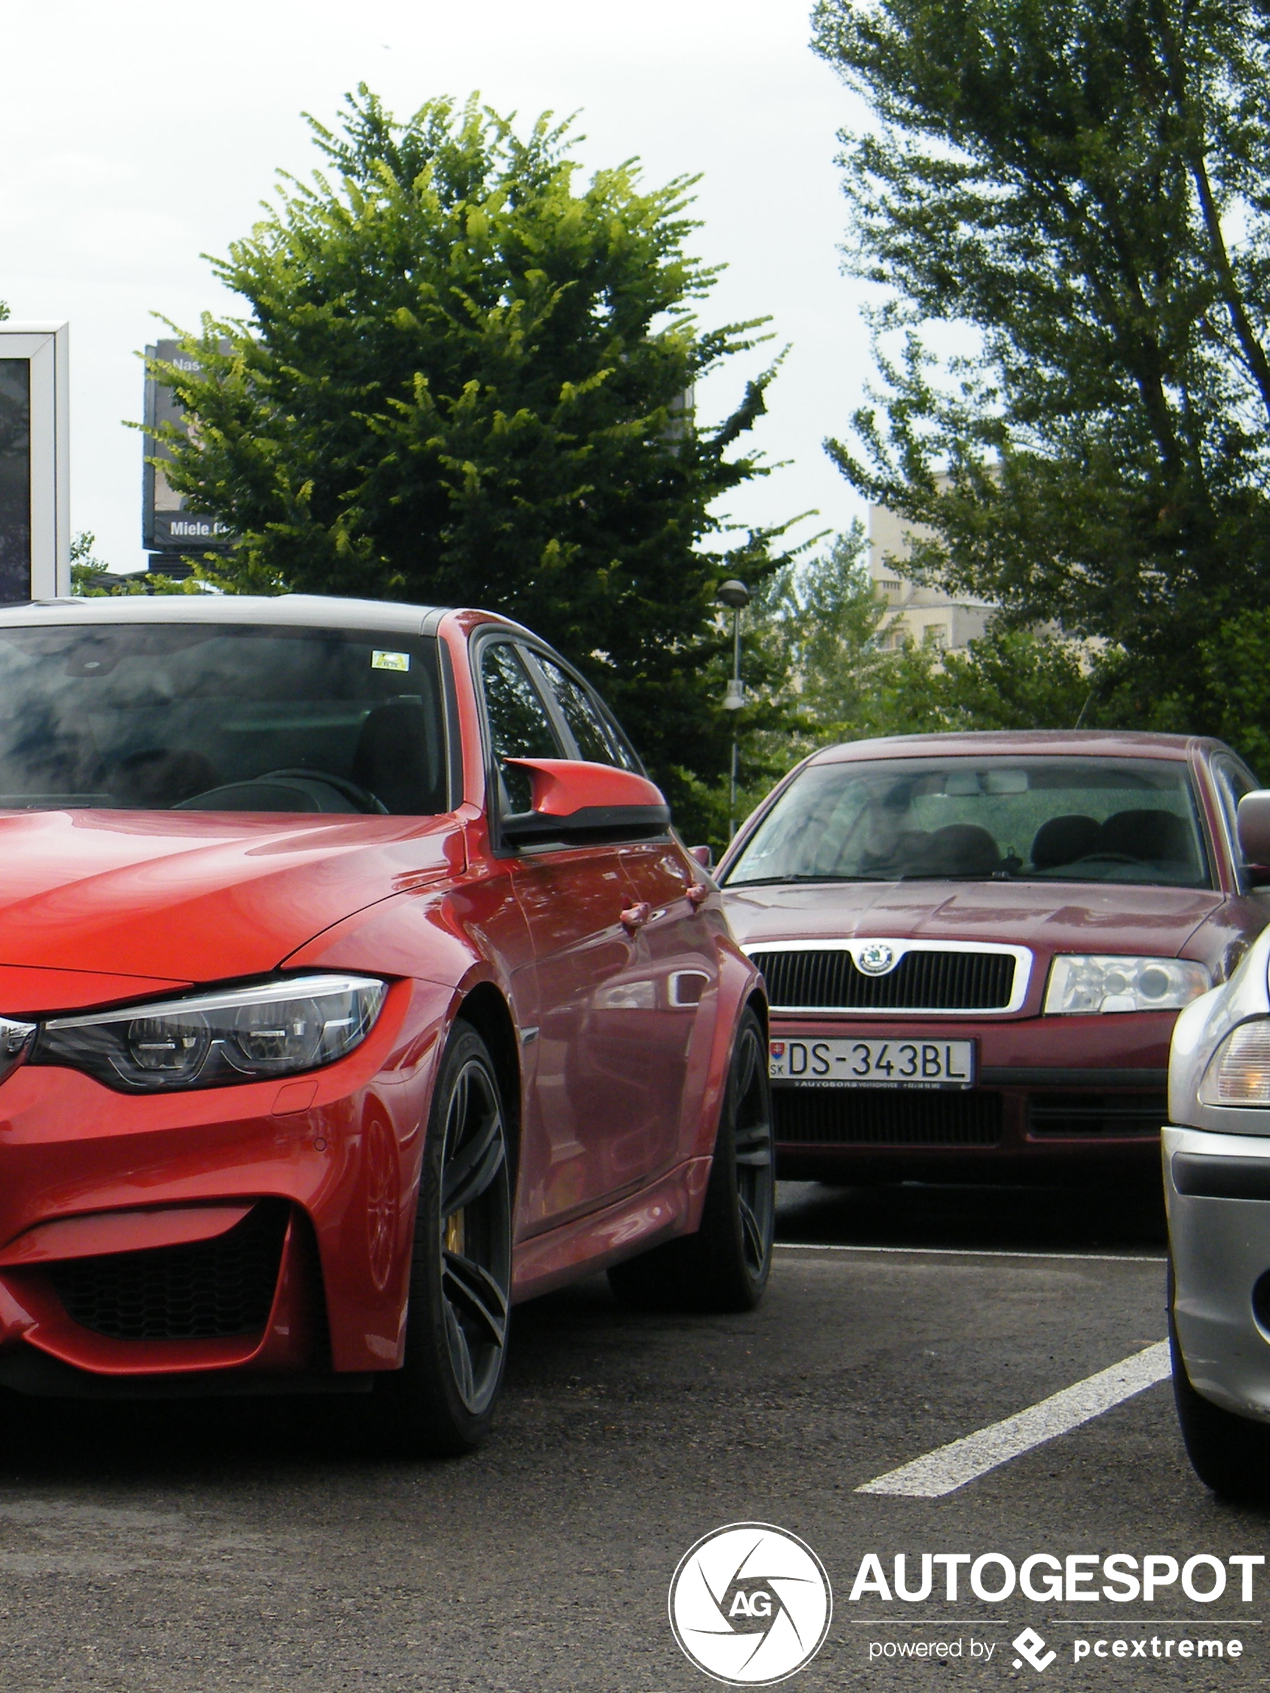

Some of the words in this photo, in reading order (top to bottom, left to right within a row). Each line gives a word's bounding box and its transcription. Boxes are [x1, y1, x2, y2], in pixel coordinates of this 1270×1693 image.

[170, 521, 210, 535] Miele
[788, 1043, 966, 1078] DS-343BL
[770, 1064, 784, 1075] SK
